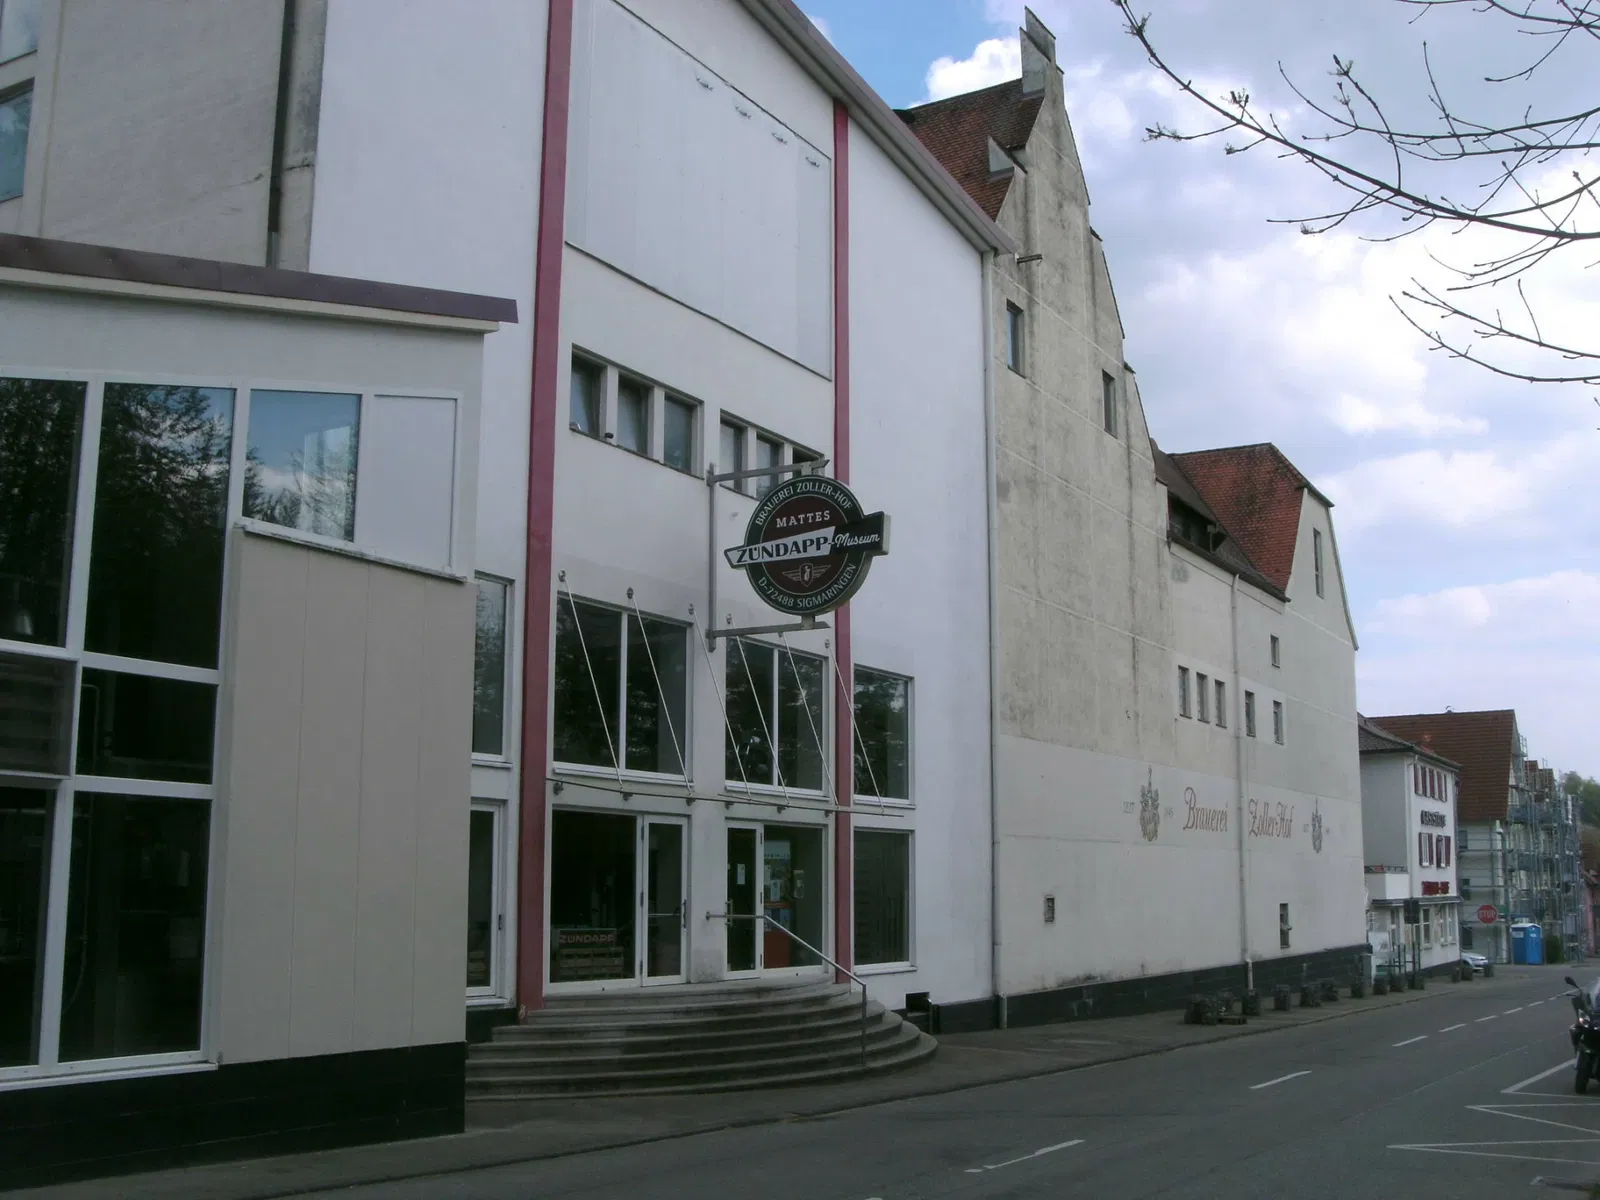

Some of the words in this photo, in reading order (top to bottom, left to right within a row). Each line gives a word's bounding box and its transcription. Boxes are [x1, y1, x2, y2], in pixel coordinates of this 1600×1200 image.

[755, 486, 794, 526] BRAUEREI
[796, 481, 853, 510] ZOLLER-HOF
[775, 510, 831, 528] MATTES
[758, 576, 794, 608] D-72488
[796, 563, 857, 608] SIGMARINGEN
[1182, 786, 1229, 832] Brauerei
[1478, 910, 1497, 919] STOP
